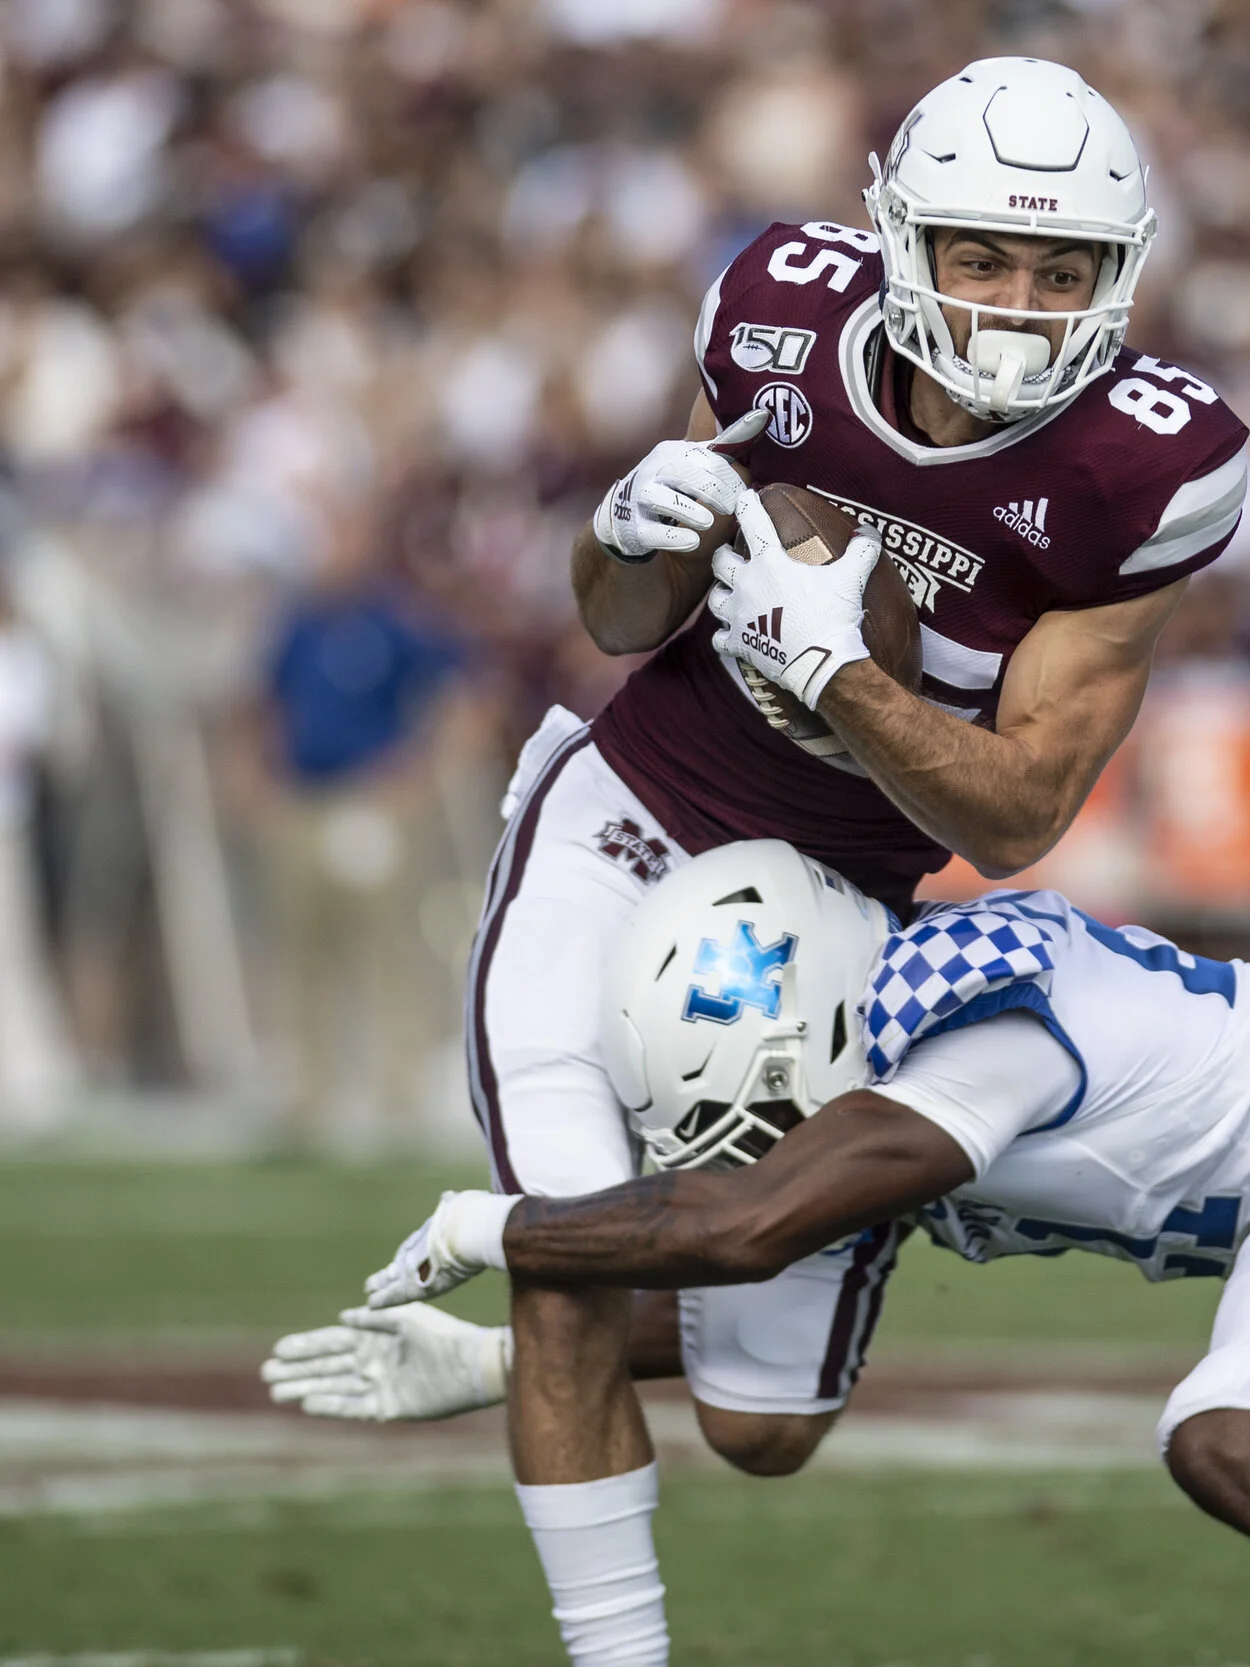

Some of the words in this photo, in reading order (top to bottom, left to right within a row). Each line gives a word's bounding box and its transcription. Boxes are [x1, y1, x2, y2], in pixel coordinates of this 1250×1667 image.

[1008, 194, 1059, 212] STATE
[767, 222, 882, 293] 85
[731, 324, 815, 373] 150
[1108, 354, 1219, 435] 85
[993, 506, 1051, 549] adidas
[741, 631, 788, 665] adidas
